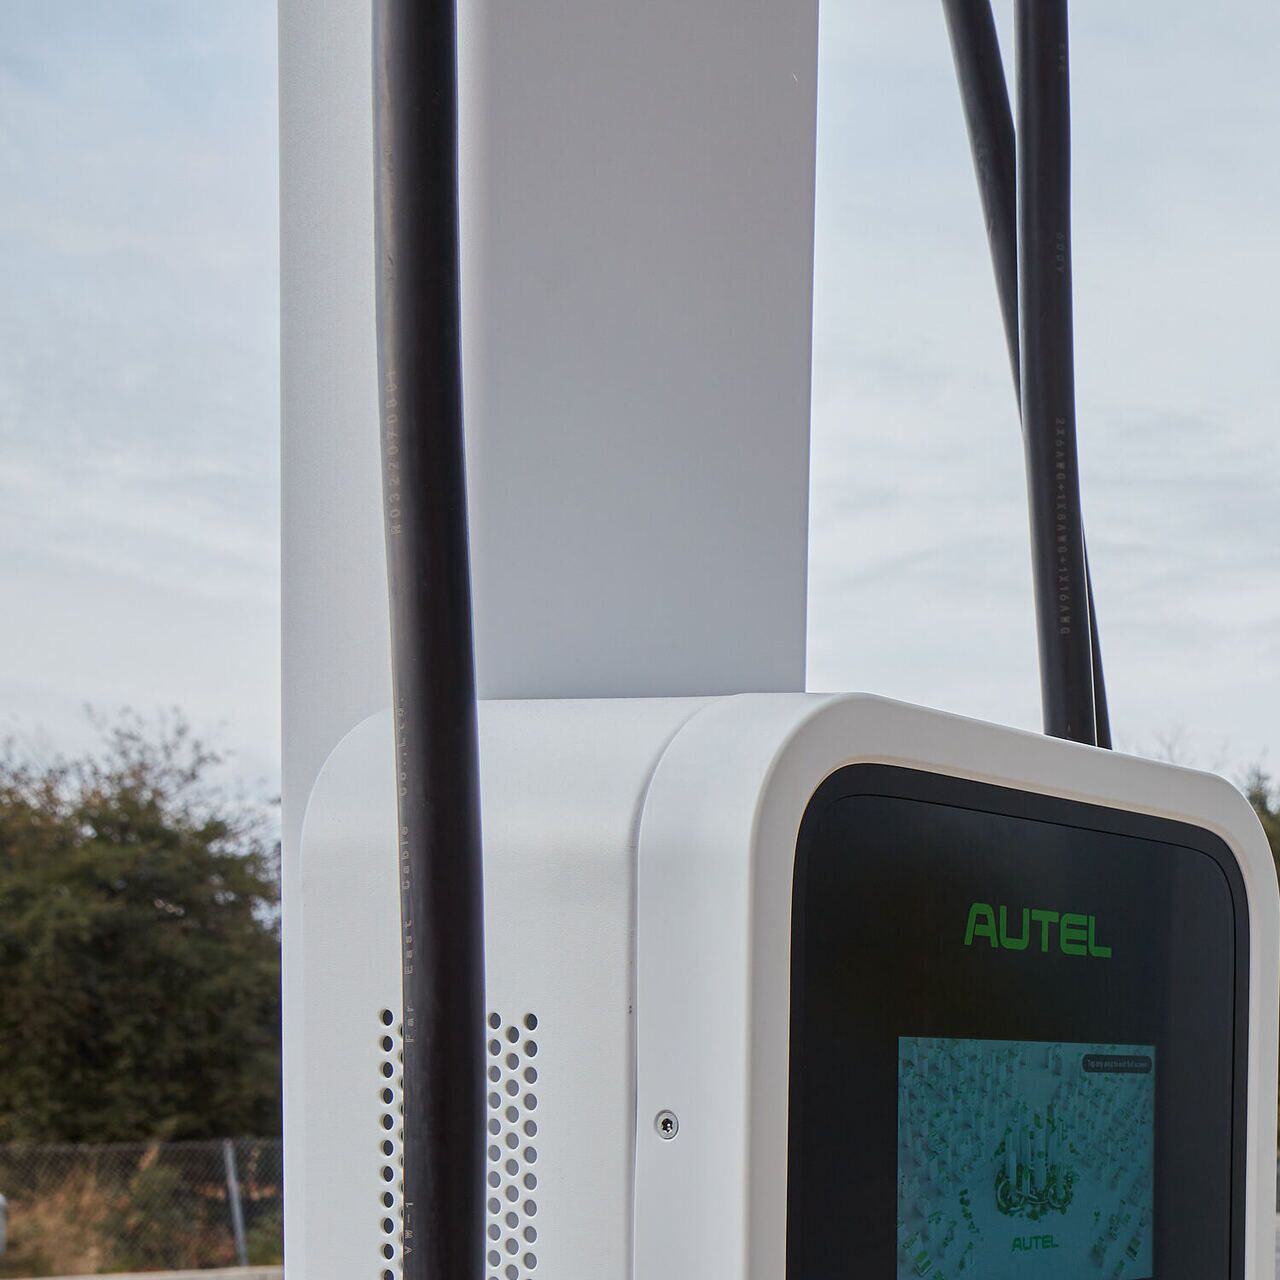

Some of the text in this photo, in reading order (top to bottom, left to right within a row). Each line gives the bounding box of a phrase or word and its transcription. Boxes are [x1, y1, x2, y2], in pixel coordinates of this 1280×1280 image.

[399, 825, 411, 890] Cable
[402, 918, 413, 976] East
[964, 902, 1113, 958] AUTEL
[404, 1004, 414, 1043] Far
[1011, 1234, 1059, 1252] AUTEL
